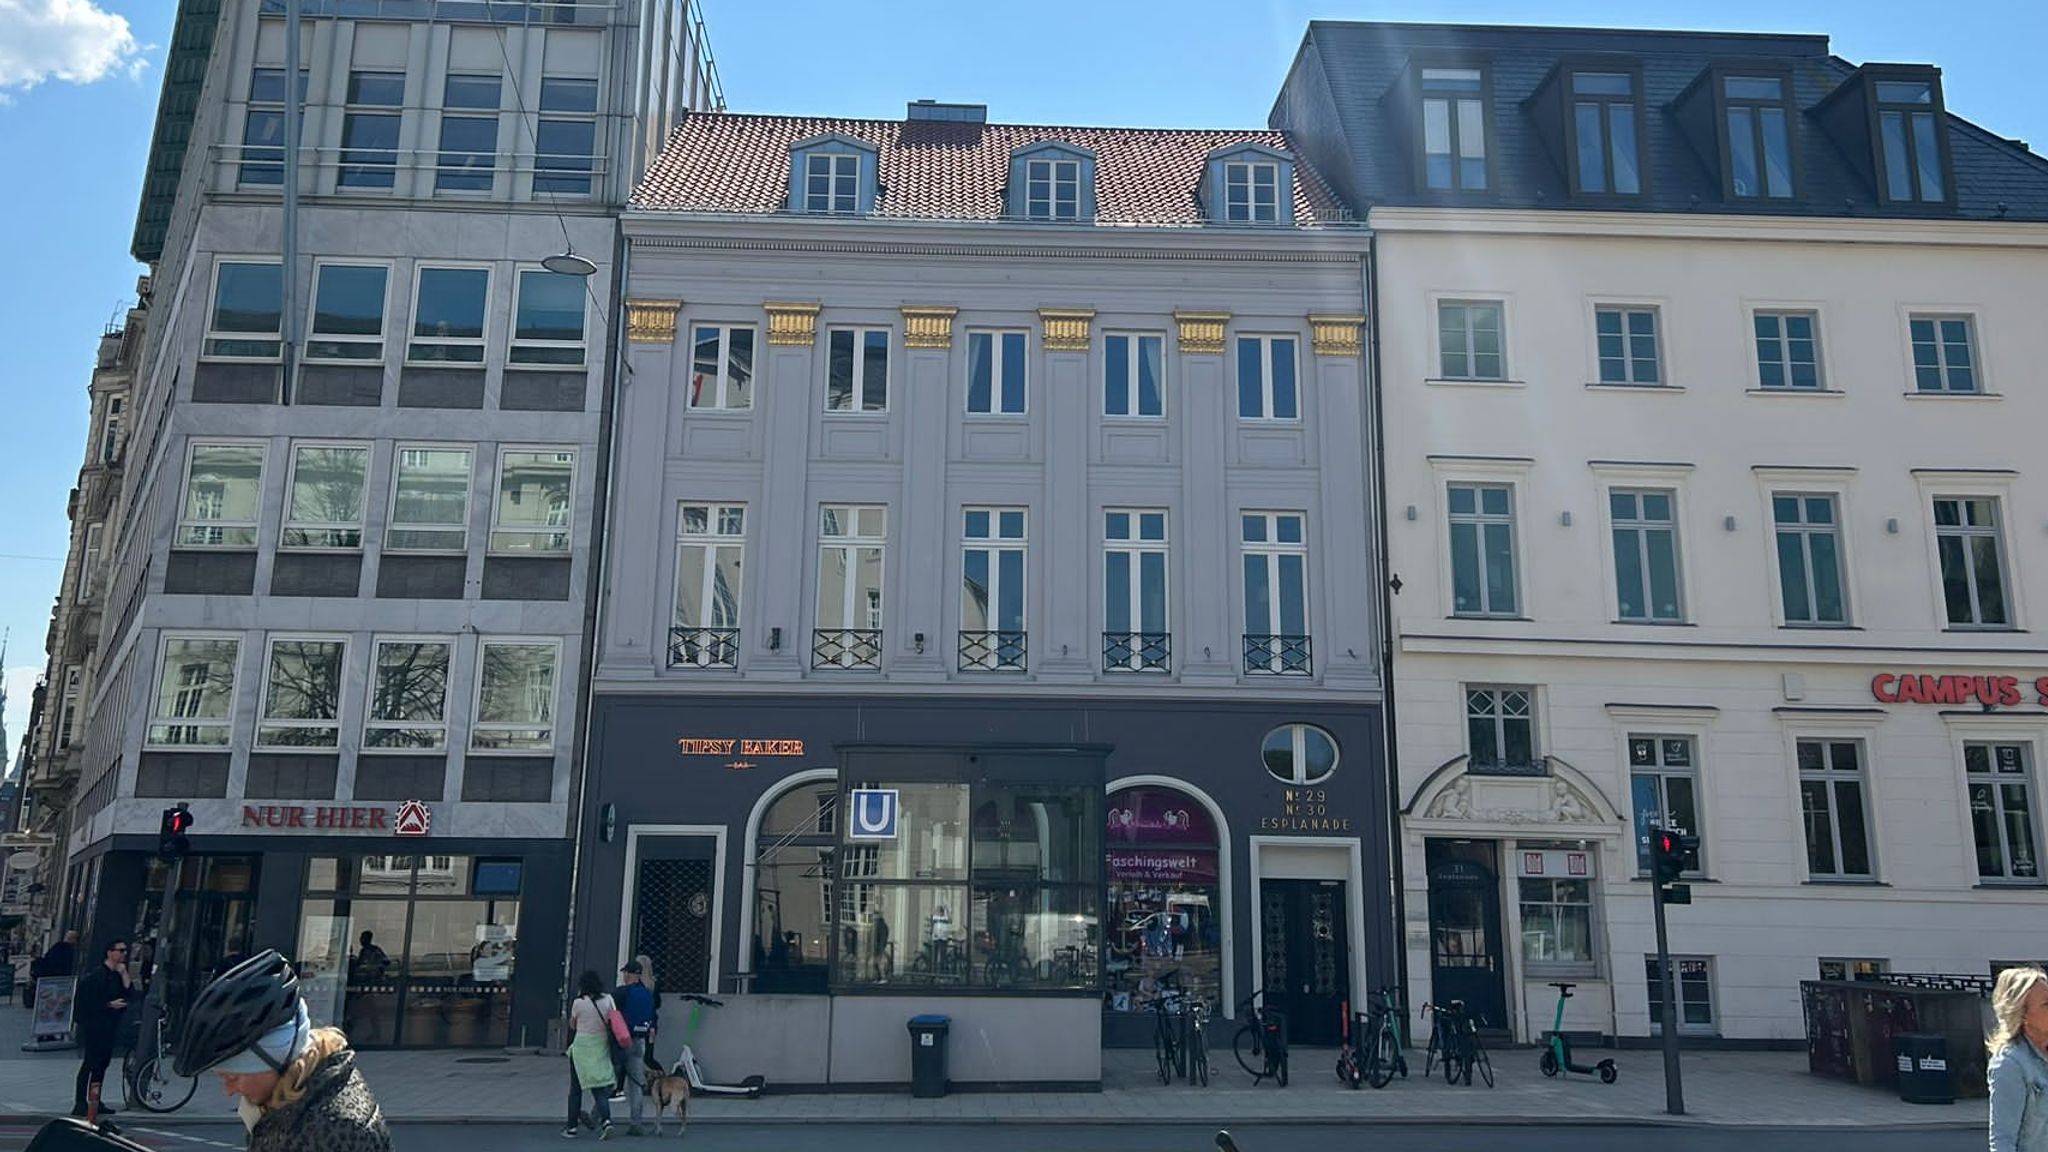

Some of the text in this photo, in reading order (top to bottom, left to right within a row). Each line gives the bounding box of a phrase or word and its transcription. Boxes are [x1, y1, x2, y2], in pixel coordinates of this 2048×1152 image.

[1872, 674, 2022, 706] CAMPUS
[679, 739, 804, 756] TIPSY BAKER
[1306, 789, 1326, 803] 29
[242, 805, 386, 829] NUR HIER
[860, 794, 890, 832] U
[1307, 804, 1326, 816] 30
[1261, 817, 1350, 831] ESPLANADE
